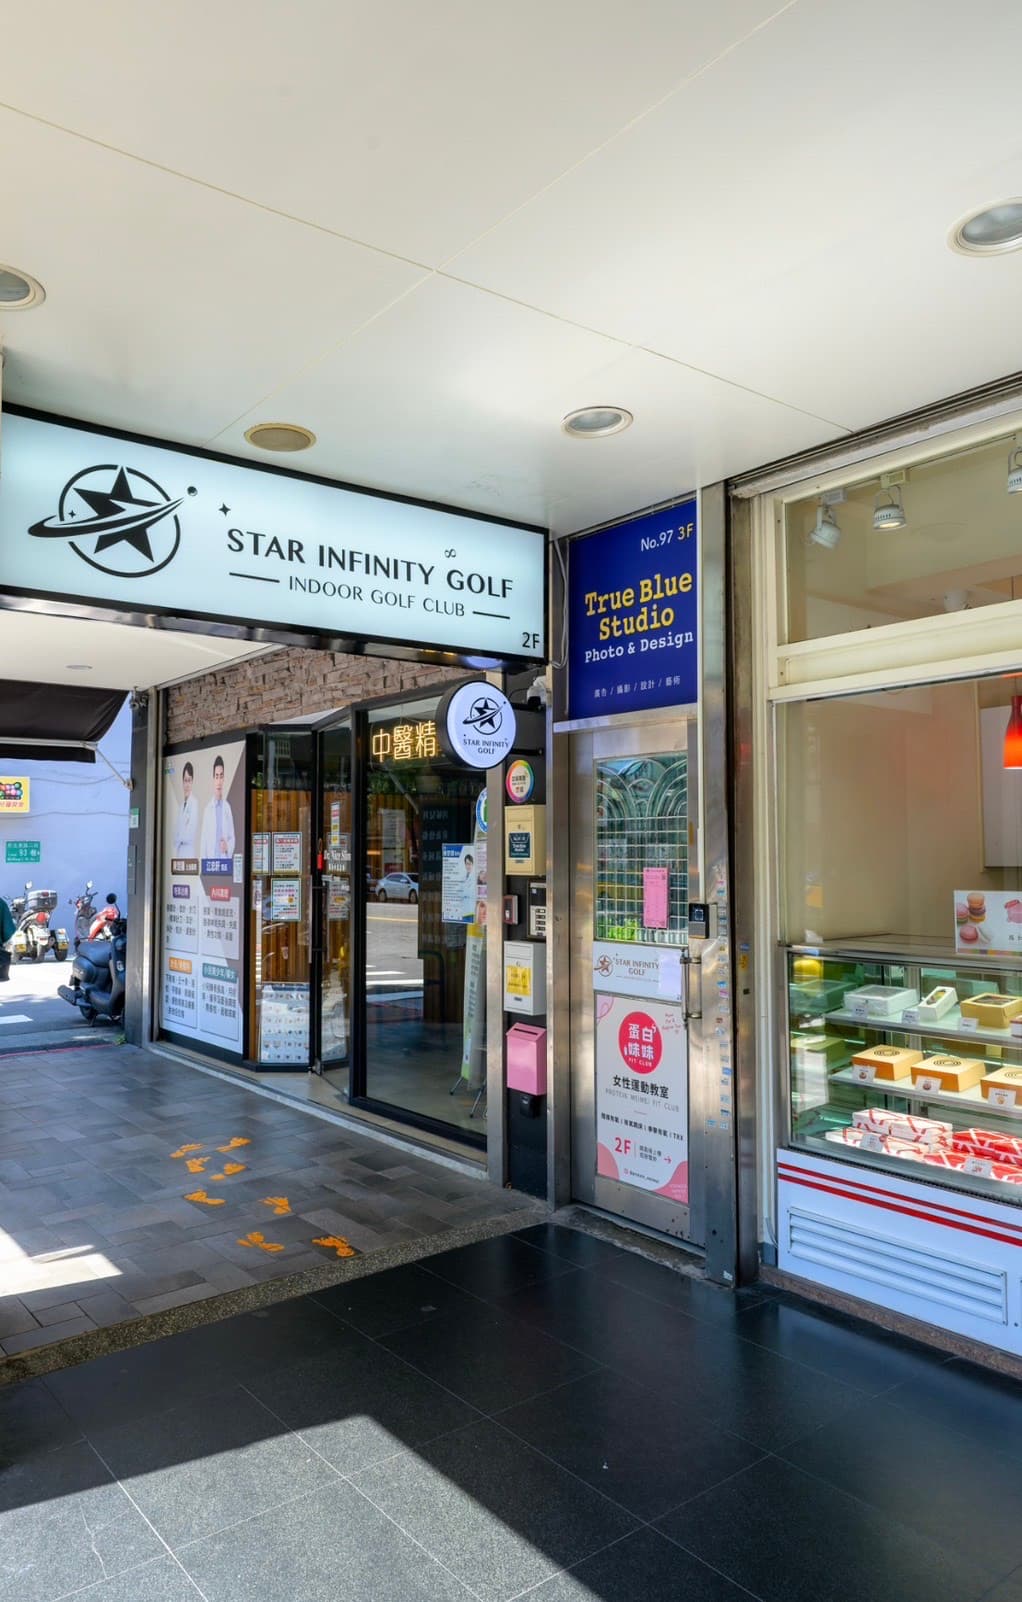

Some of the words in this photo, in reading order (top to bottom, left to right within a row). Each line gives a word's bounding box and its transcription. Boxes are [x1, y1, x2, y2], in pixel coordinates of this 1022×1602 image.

[641, 530, 673, 551] No.97
[678, 523, 693, 541] 3F
[226, 528, 306, 564] STAR
[318, 545, 434, 585] INFINITY
[446, 570, 513, 598] GOLF
[288, 576, 363, 602] INDOOR
[370, 589, 415, 609] GOLF
[422, 598, 465, 617] CLUB
[585, 586, 634, 616] True
[639, 572, 692, 604] Blue
[599, 604, 674, 641] Studio
[522, 632, 540, 650] 2F
[584, 644, 624, 664] Photo
[627, 642, 636, 654] &
[640, 630, 694, 652] Design
[640, 680, 654, 691] 設計
[463, 738, 480, 746] STAR
[482, 740, 509, 748] INFINITY
[615, 958, 631, 967] STAR
[632, 960, 659, 969] INFINITY
[628, 968, 645, 976] GOLF
[612, 1074, 669, 1100] 女性運動教室
[614, 1137, 632, 1155] 2F
